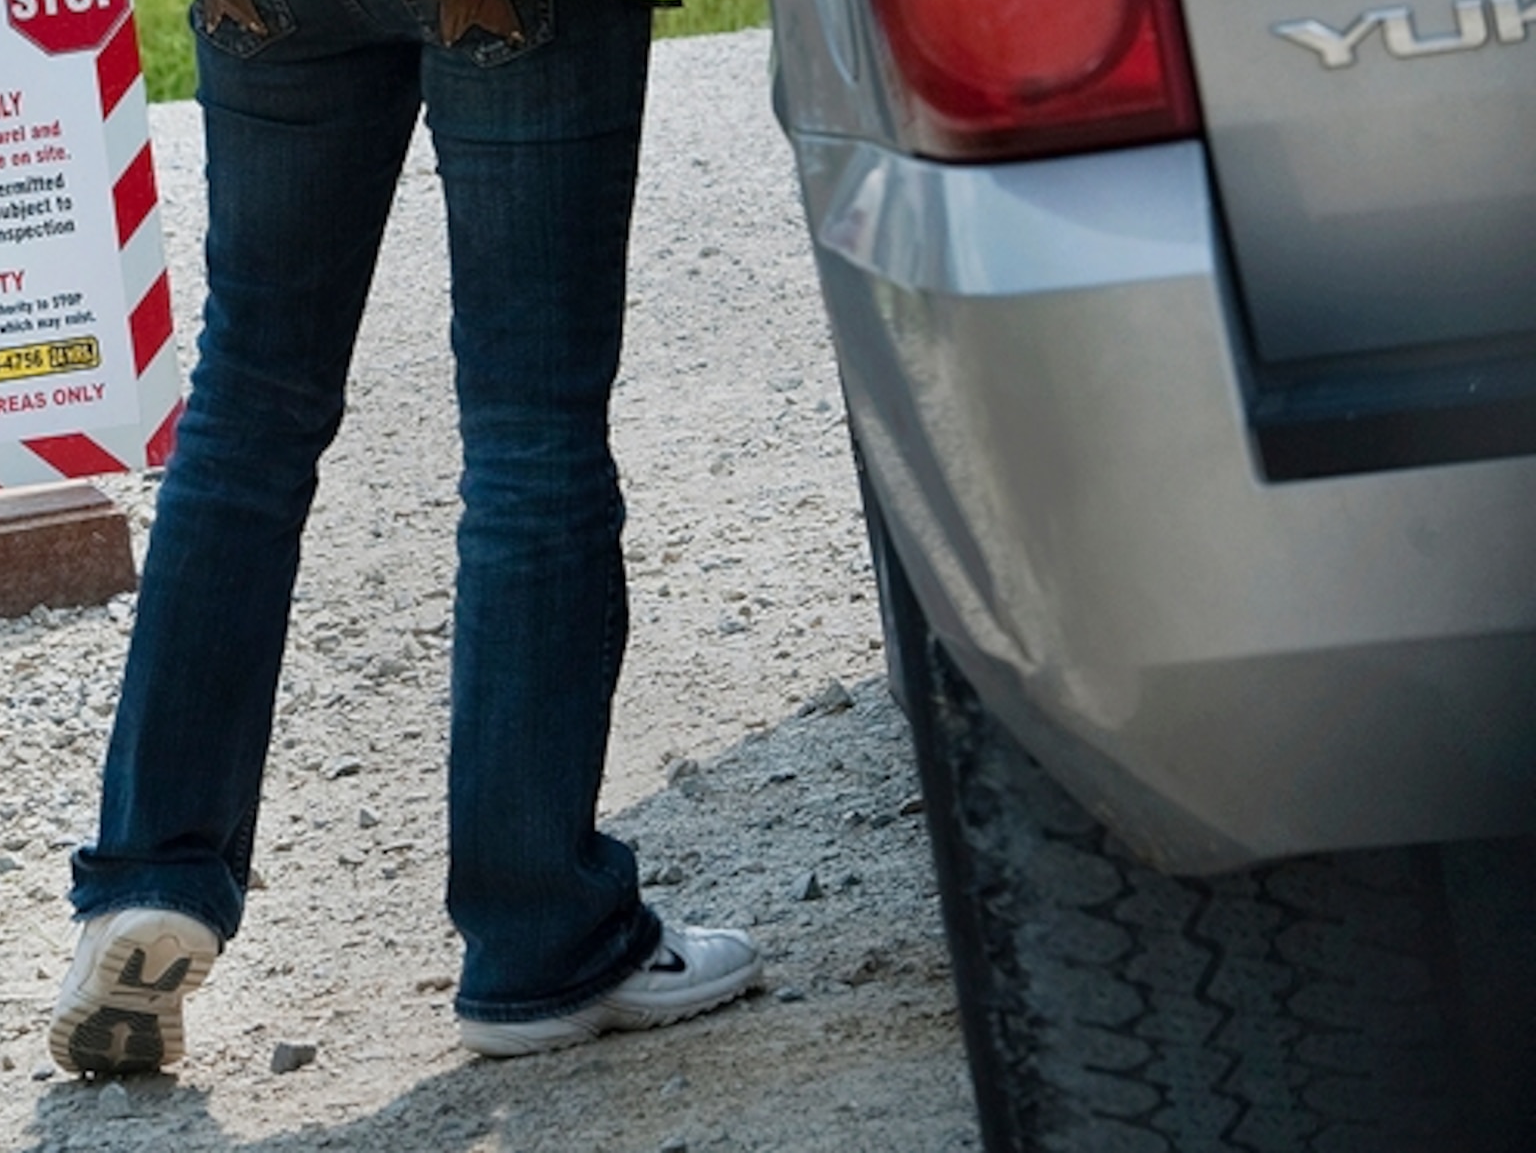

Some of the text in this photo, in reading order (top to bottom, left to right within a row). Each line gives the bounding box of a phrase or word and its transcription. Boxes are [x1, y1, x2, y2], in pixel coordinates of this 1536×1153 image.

[31, 120, 61, 138] and
[12, 151, 30, 166] on
[36, 145, 71, 162] site.
[56, 196, 72, 212] to
[53, 383, 106, 407] ONLY
